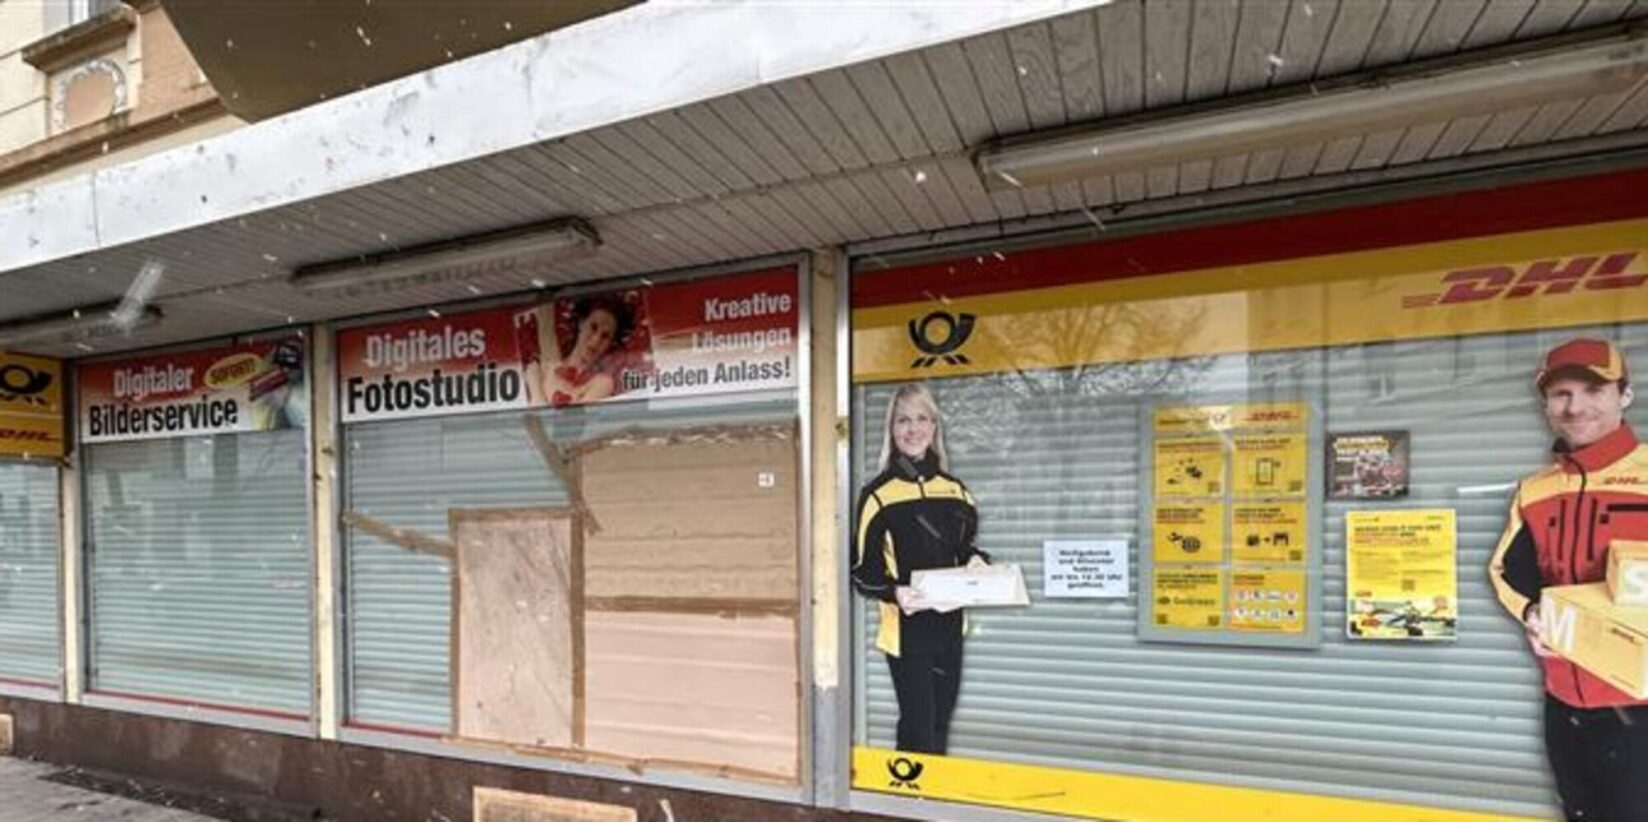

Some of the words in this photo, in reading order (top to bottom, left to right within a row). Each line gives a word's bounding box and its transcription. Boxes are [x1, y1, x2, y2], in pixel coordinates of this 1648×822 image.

[1437, 251, 1648, 304] DHL
[705, 292, 791, 321] Kreative
[365, 326, 486, 371] Digitales
[692, 326, 792, 353] Lösungen
[113, 364, 194, 400] Digitaler
[348, 362, 520, 414] Fotostudio
[623, 369, 647, 390] für
[653, 366, 708, 392] jeden
[714, 357, 790, 384] Anlass!
[89, 395, 238, 437] Bilderservice
[1541, 591, 1576, 652] M
